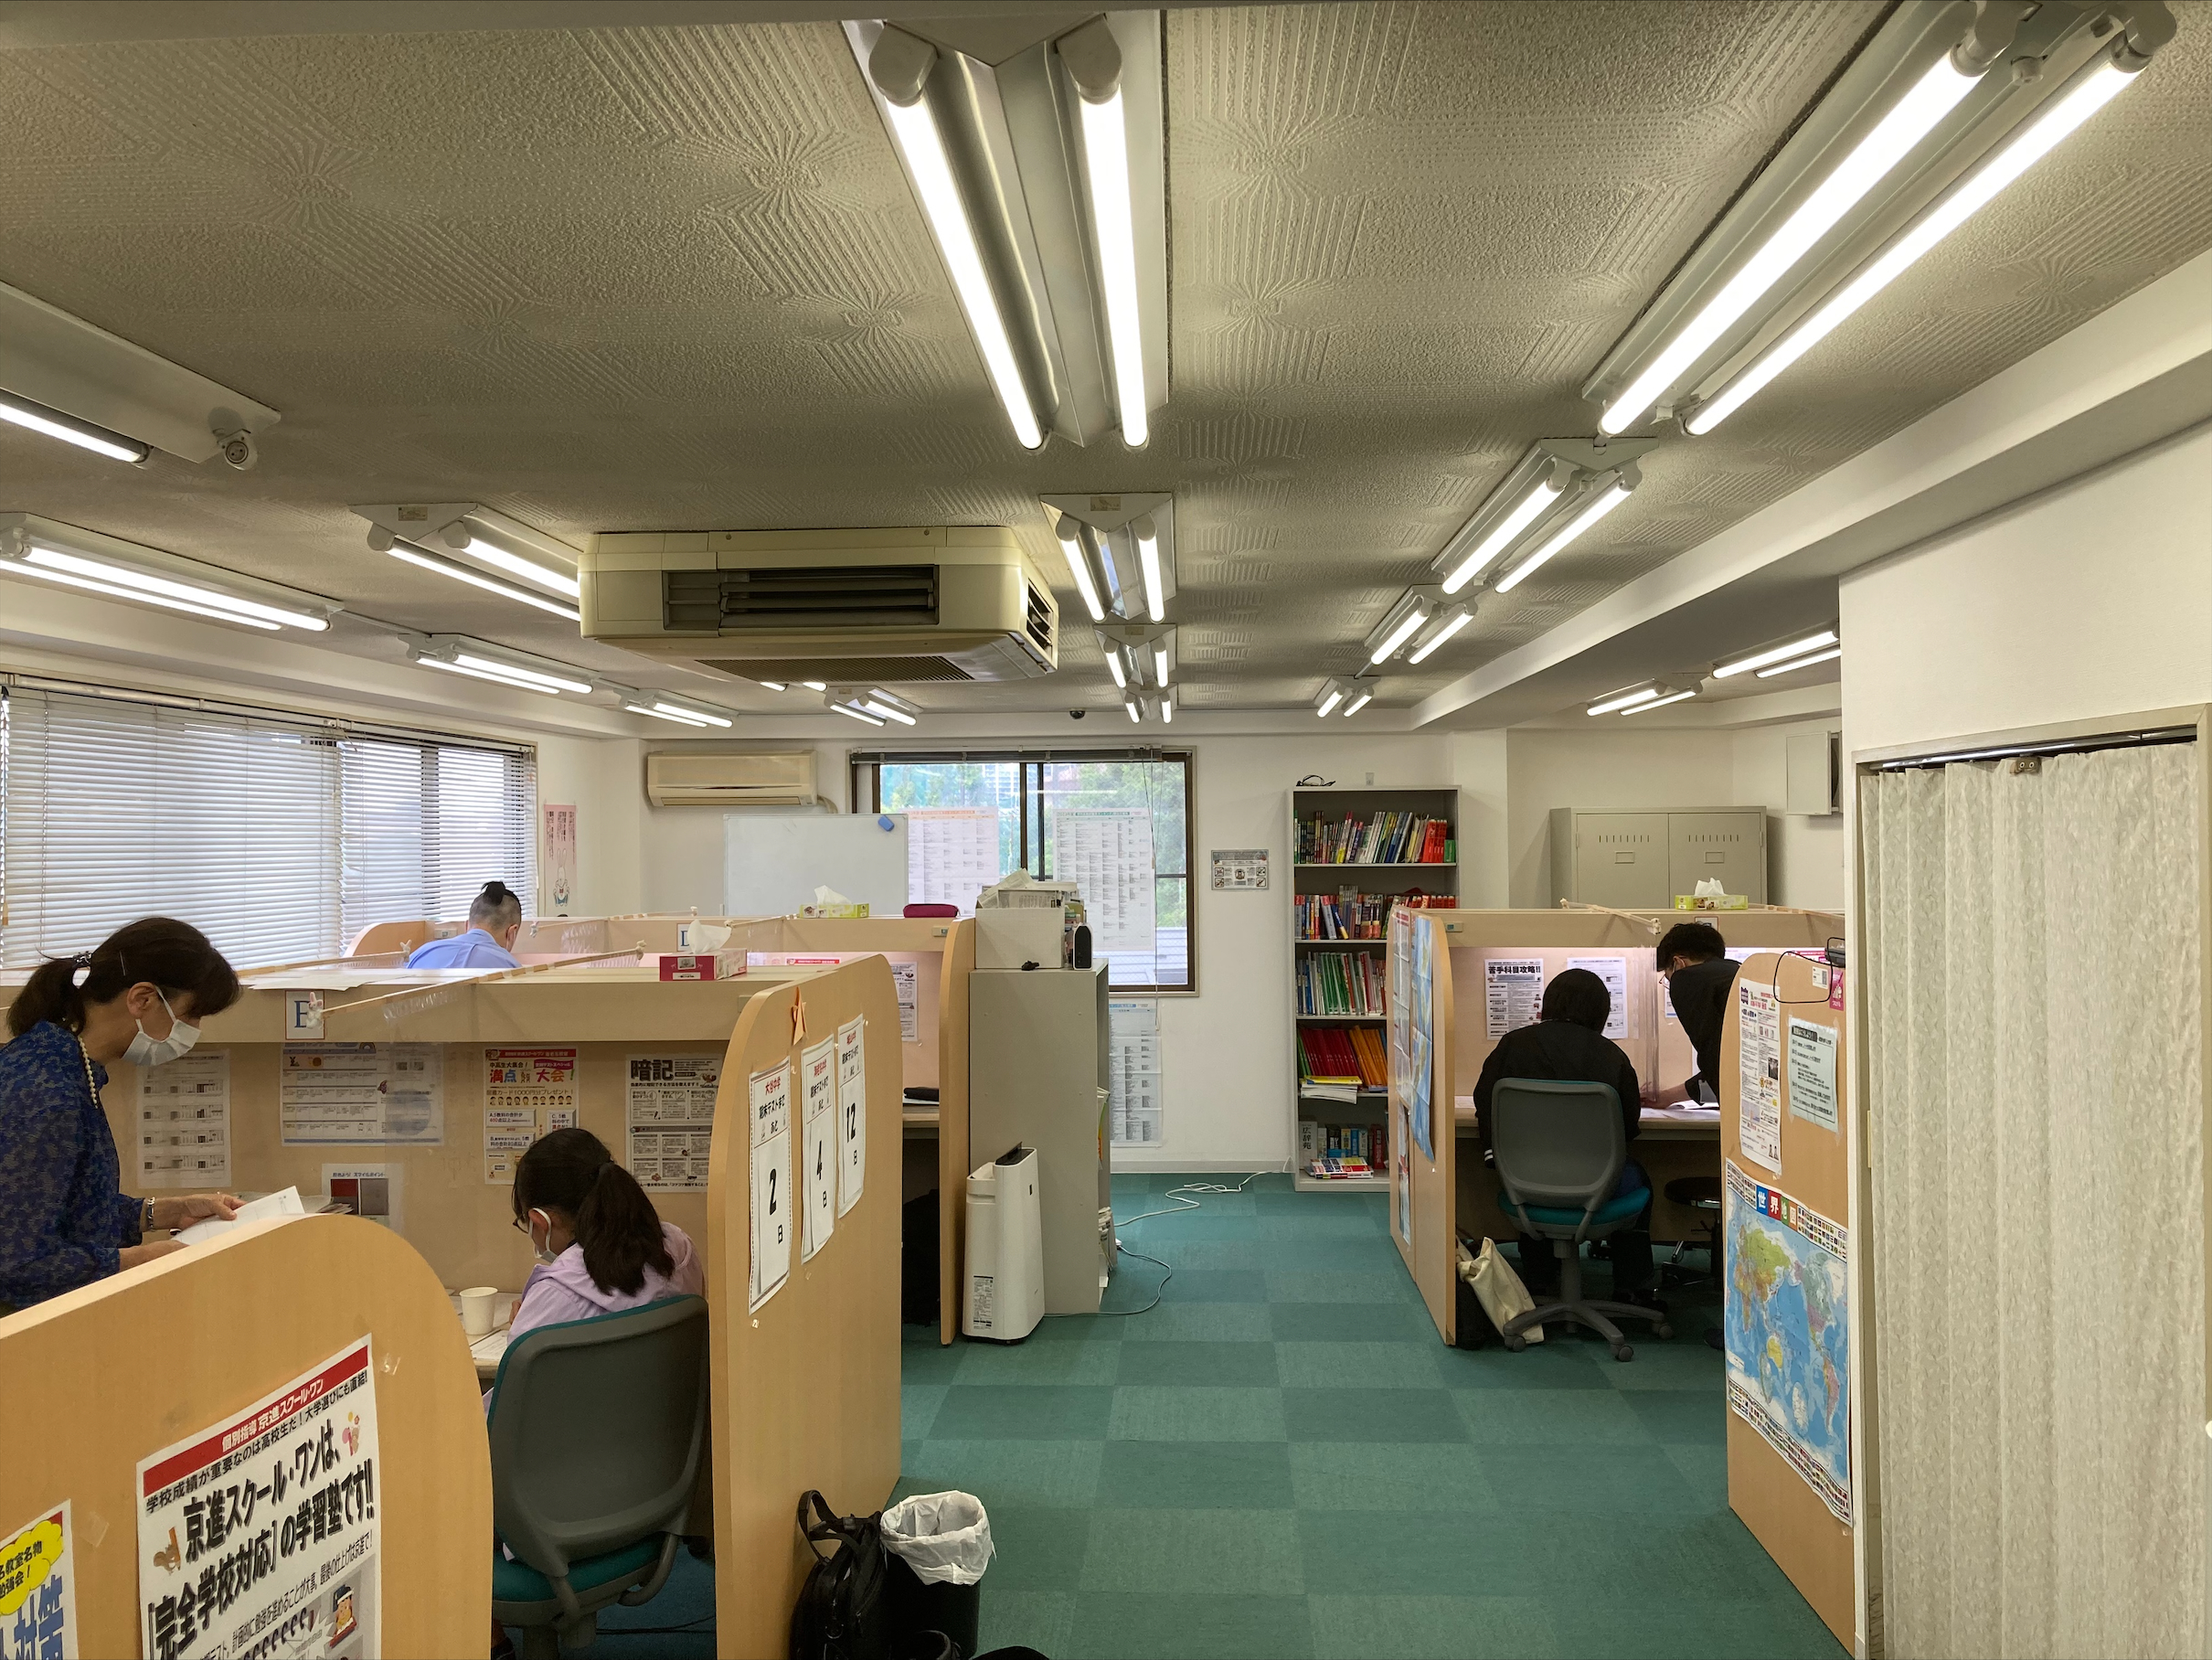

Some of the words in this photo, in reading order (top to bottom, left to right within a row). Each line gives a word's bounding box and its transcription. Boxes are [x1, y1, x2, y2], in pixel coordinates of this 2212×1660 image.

[630, 1059, 675, 1082] 暗記
[759, 1094, 786, 1121] 期末テストまで
[771, 1120, 779, 1134] あと
[846, 1102, 856, 1144] 12
[1303, 1126, 1312, 1150] 広辞苑
[816, 1140, 823, 1181] 4
[853, 1149, 857, 1165] 日
[769, 1168, 777, 1216] 2
[823, 1190, 827, 1208] 日
[777, 1224, 783, 1244] 日
[221, 1421, 257, 1453] 個別指導
